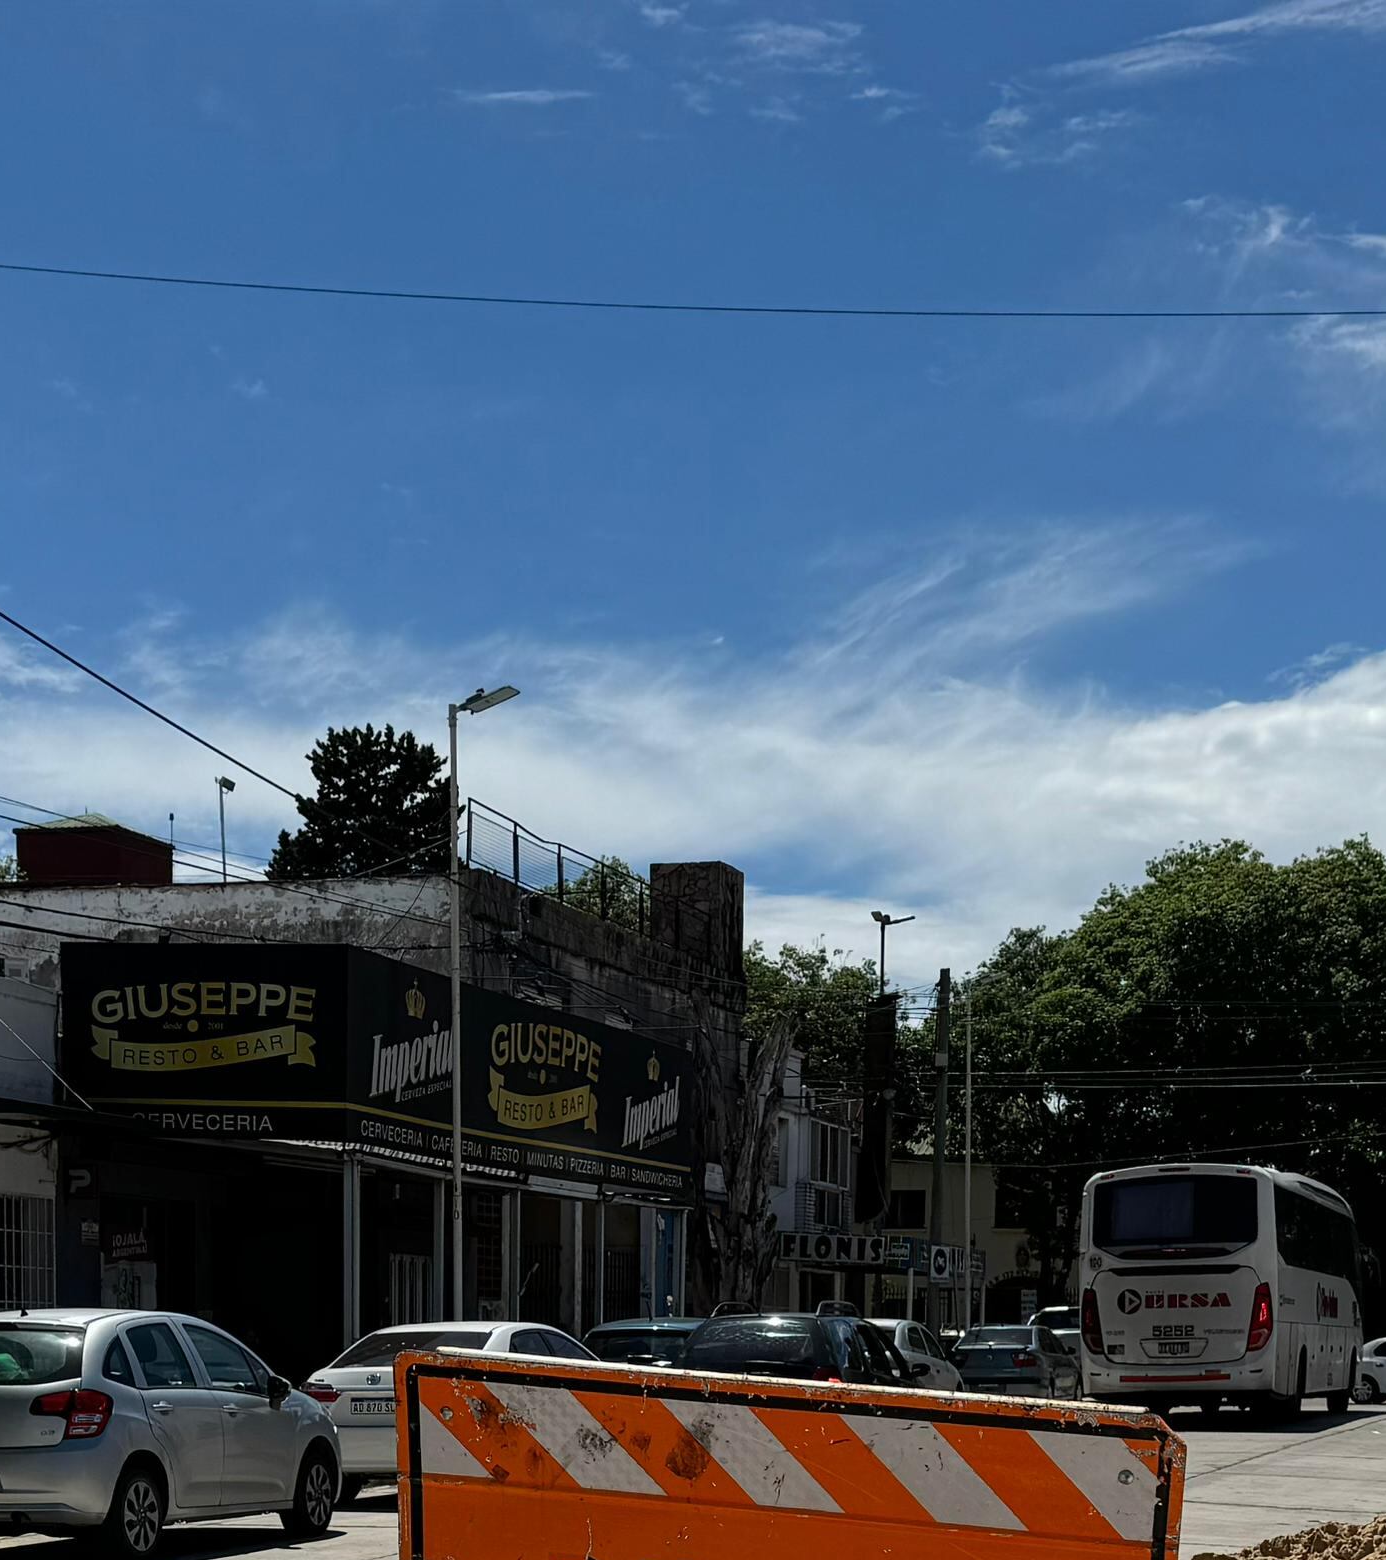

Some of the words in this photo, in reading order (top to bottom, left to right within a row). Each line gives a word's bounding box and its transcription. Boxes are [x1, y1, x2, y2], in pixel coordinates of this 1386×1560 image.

[90, 981, 317, 1025] GIUSEPPE
[122, 1047, 198, 1066] RESTO
[211, 1045, 225, 1060] &
[236, 1034, 284, 1056] BAR
[490, 1022, 603, 1084] GIUSEPPE
[504, 1100, 543, 1122] RESTO
[549, 1101, 556, 1118] &
[561, 1095, 585, 1116] BAR
[620, 1074, 681, 1151] Imperial
[360, 1119, 423, 1148] CERVECERIA
[431, 1135, 483, 1158] CAFEERIA
[490, 1146, 520, 1164] RESTO
[526, 1154, 564, 1171] MINUTAS
[570, 1158, 604, 1176] PIZZERIA
[610, 1164, 625, 1179] BAR
[631, 1168, 683, 1188] SANDWICHERIA
[783, 1234, 882, 1263] FLONIS
[1152, 1325, 1196, 1338] 5252
[353, 1403, 364, 1412] AD
